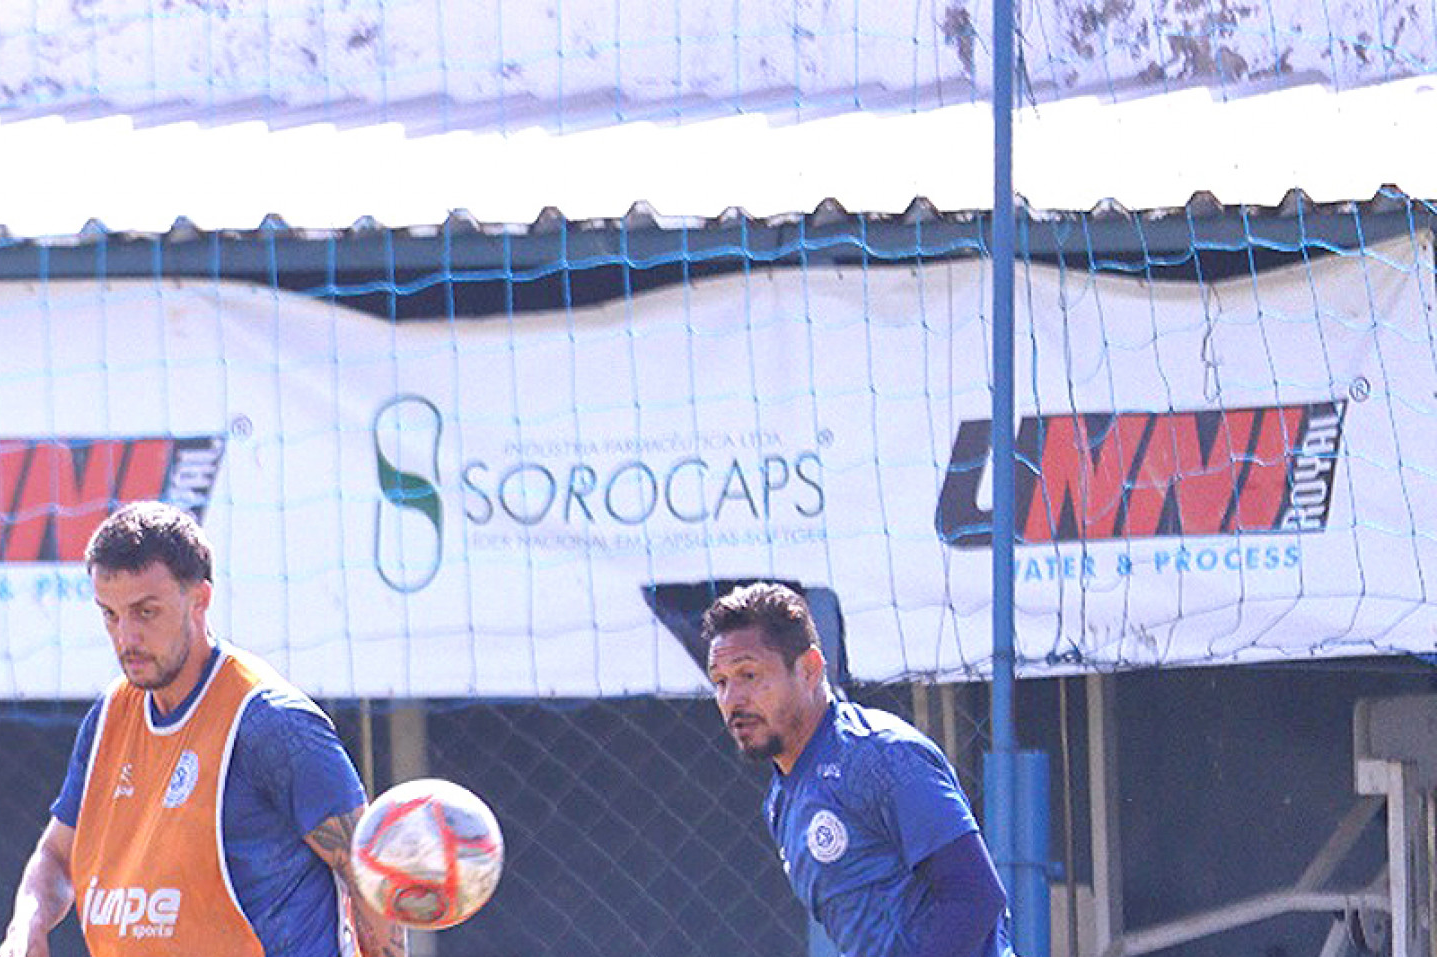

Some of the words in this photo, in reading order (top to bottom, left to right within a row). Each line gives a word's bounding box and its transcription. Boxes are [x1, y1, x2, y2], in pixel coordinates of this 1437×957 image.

[462, 450, 825, 526] SOROCAPS
[1117, 553, 1132, 576] &
[1154, 545, 1300, 573] PROCESS
